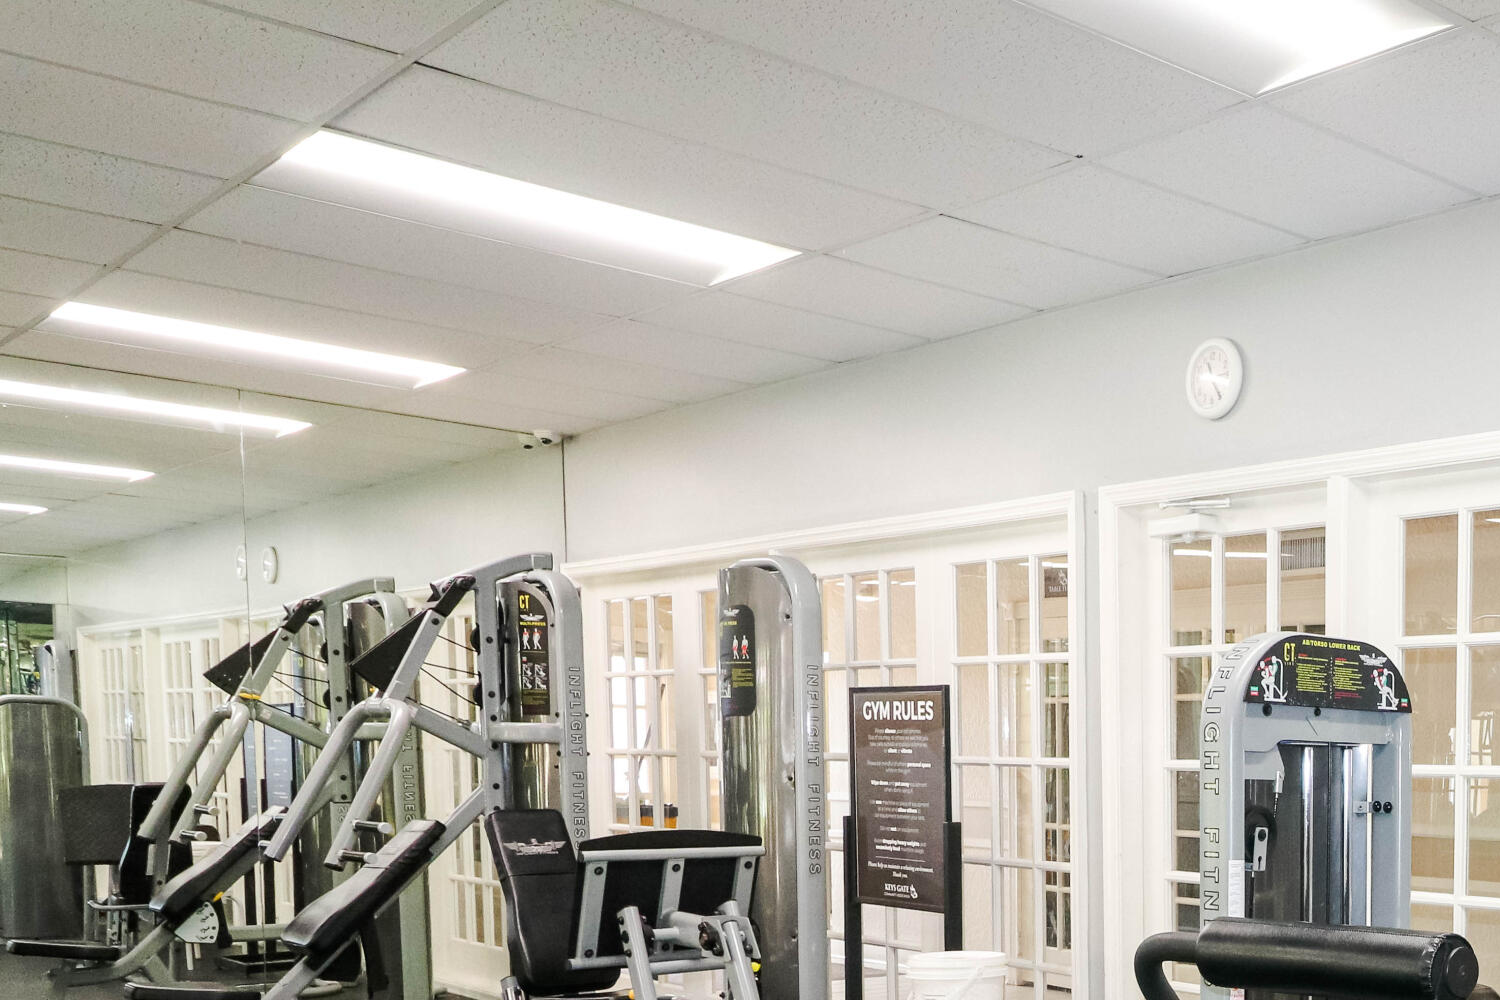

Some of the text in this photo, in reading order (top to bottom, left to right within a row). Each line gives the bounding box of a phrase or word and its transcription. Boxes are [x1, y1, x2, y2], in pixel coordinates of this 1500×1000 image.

[519, 595, 529, 609] CT
[1329, 642, 1347, 650] LOWER
[1347, 643, 1361, 652] BACK
[568, 667, 584, 757] INFLIGHT
[863, 700, 934, 721] GYM RULES
[806, 664, 821, 875] INFLIGHT FITNESS
[1203, 639, 1260, 932] INFLIGHT FITN
[884, 883, 909, 893] KEYS GATE
